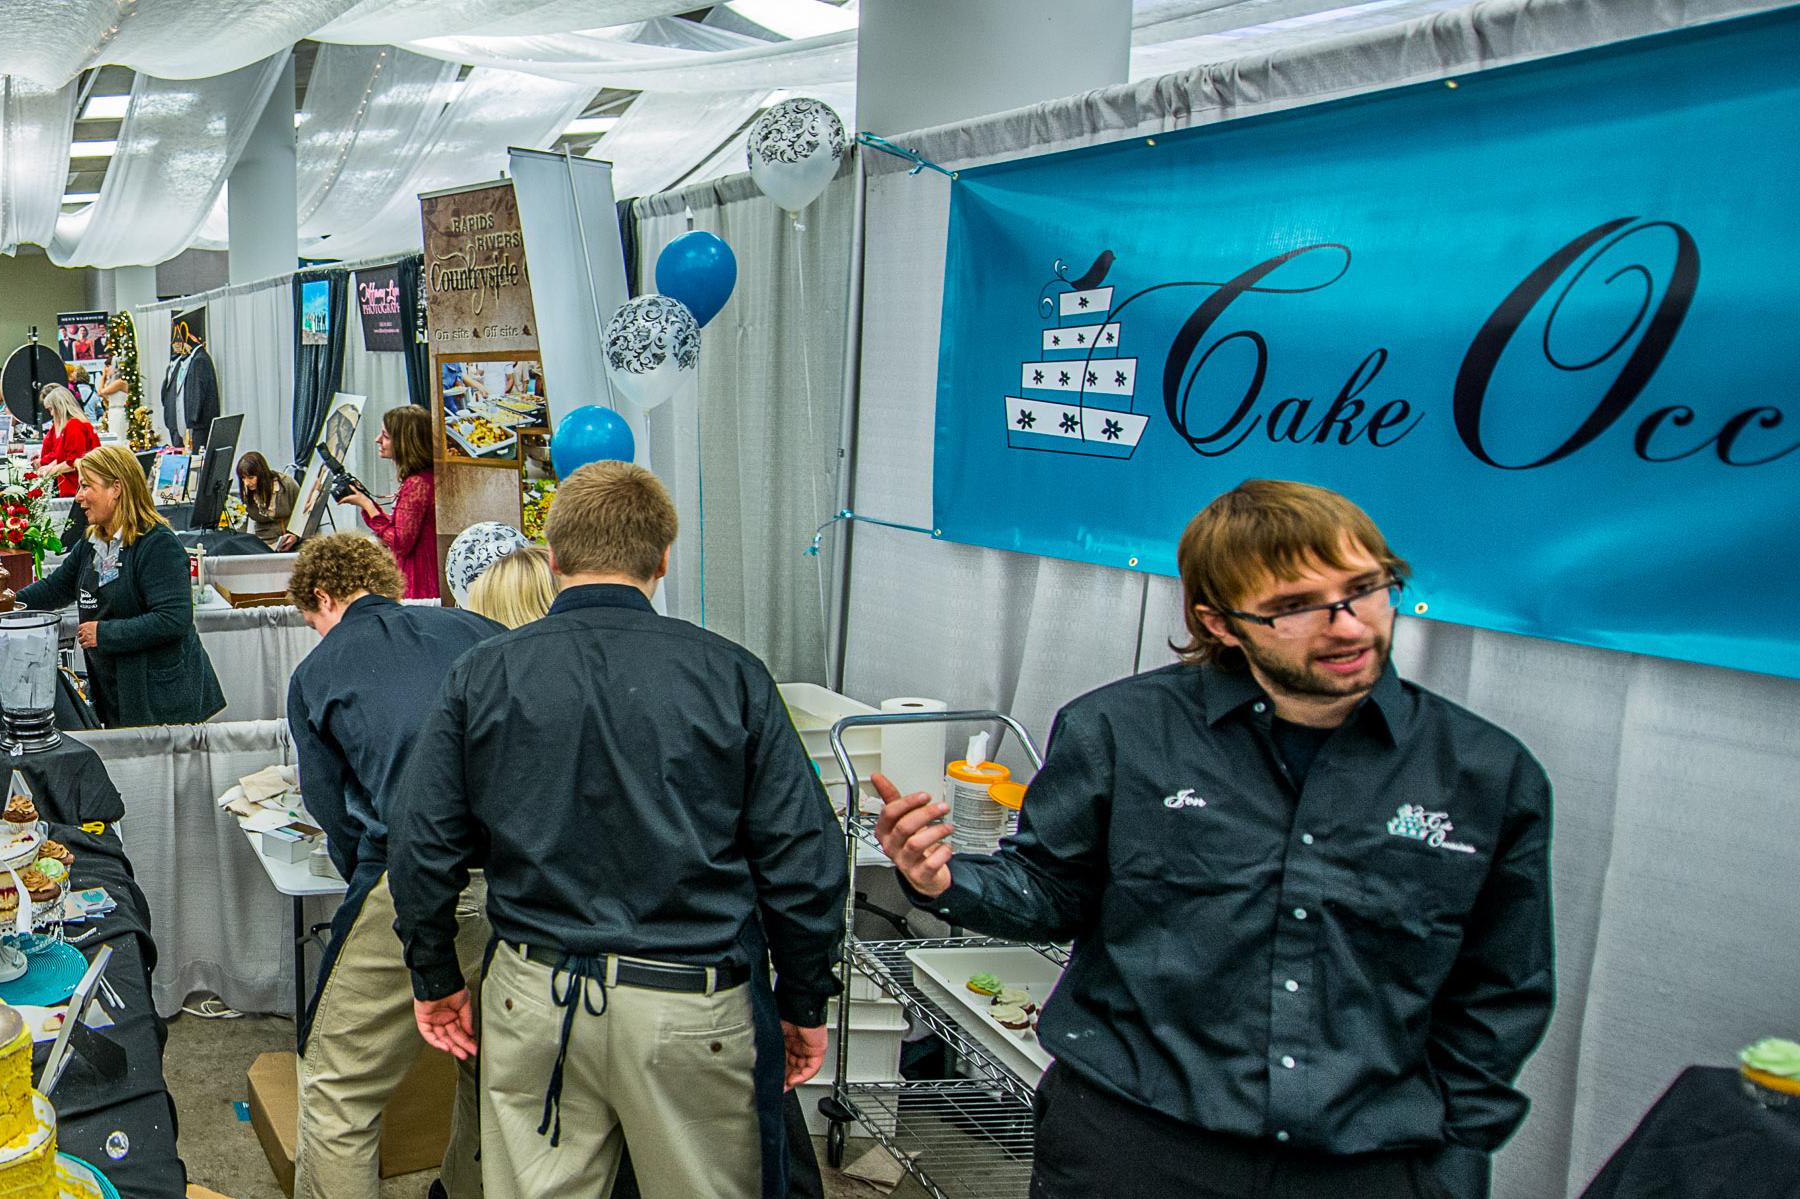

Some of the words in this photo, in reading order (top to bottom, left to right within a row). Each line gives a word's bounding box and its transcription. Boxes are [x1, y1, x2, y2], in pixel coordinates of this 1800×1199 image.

[452, 212, 496, 234] RAPIDS
[430, 244, 519, 312] Countryside
[435, 328, 450, 341] On
[452, 326, 470, 340] site
[483, 324, 499, 339] Off
[501, 324, 520, 338] site
[1082, 243, 1426, 457] Cake
